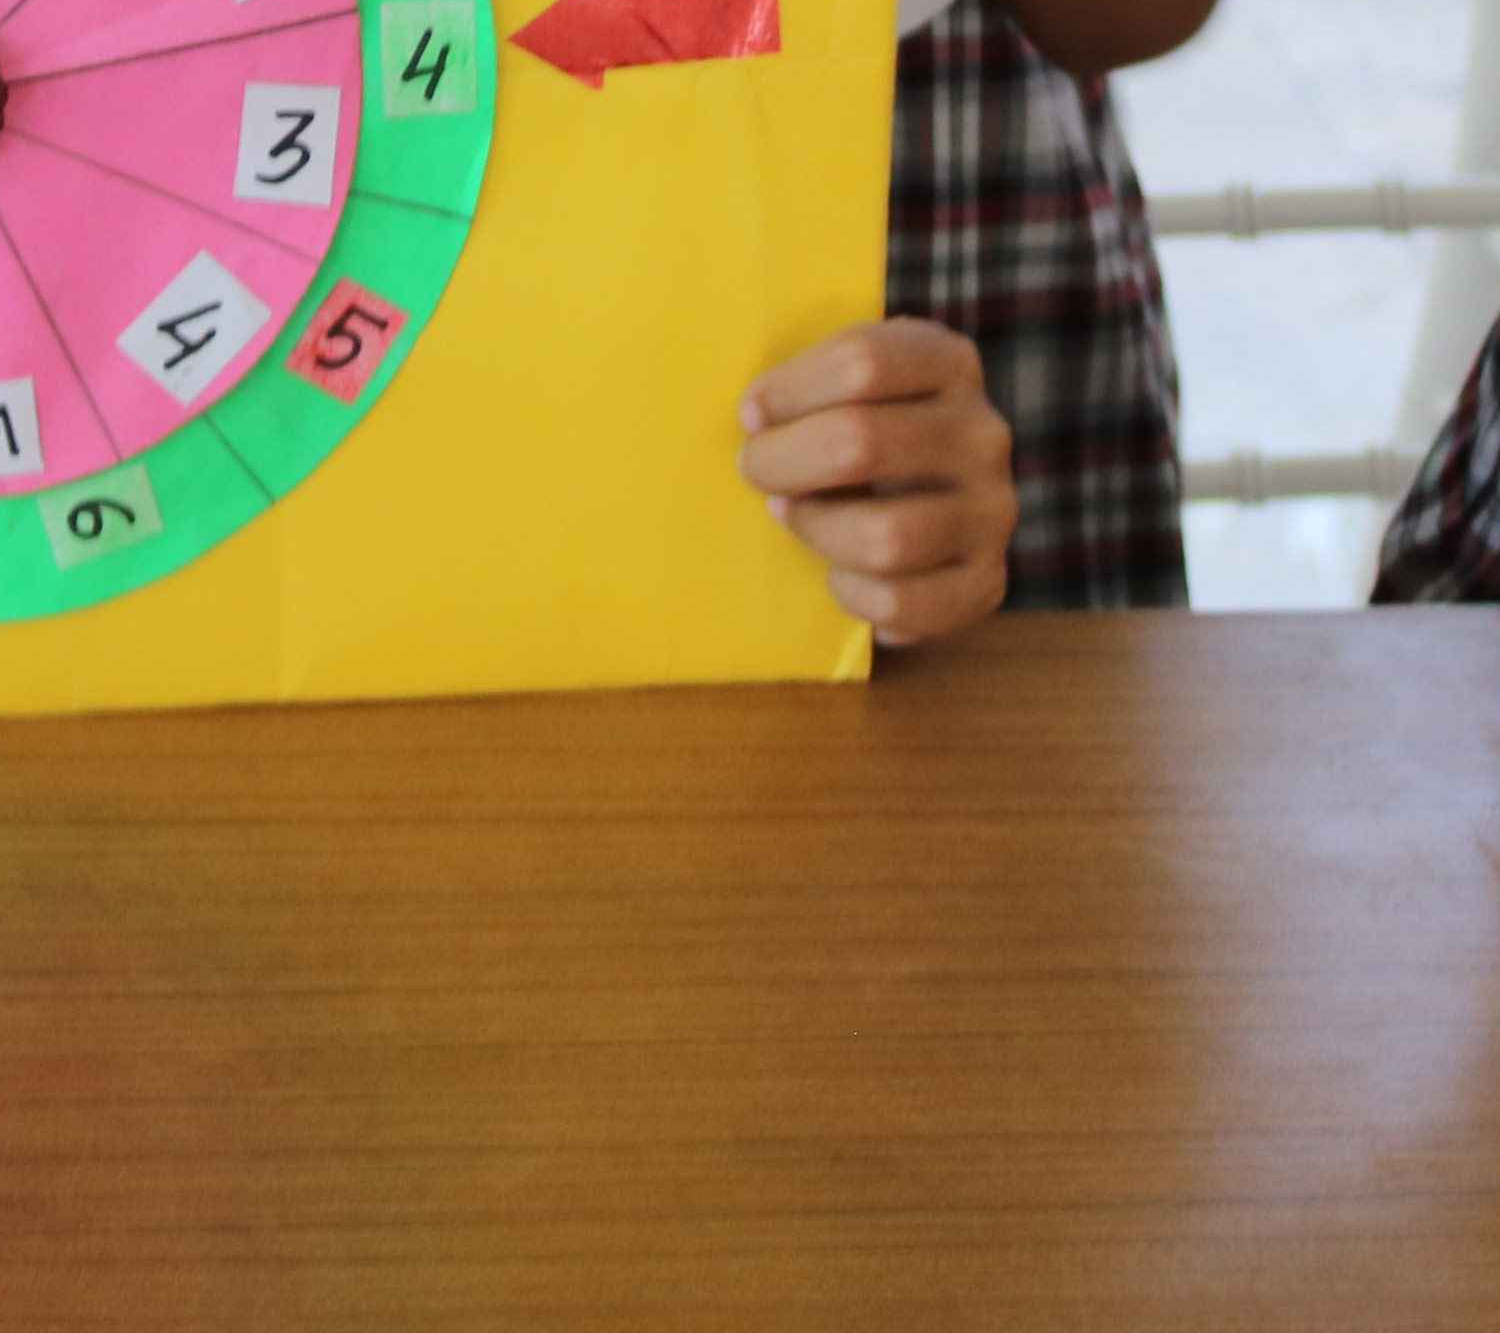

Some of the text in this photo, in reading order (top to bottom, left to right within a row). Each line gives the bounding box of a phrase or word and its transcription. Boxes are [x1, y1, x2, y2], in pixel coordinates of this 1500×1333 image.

[400, 28, 451, 102] 4
[255, 111, 316, 185] 3
[156, 303, 220, 370] 4
[317, 303, 389, 371] 5
[66, 499, 136, 539] 6
